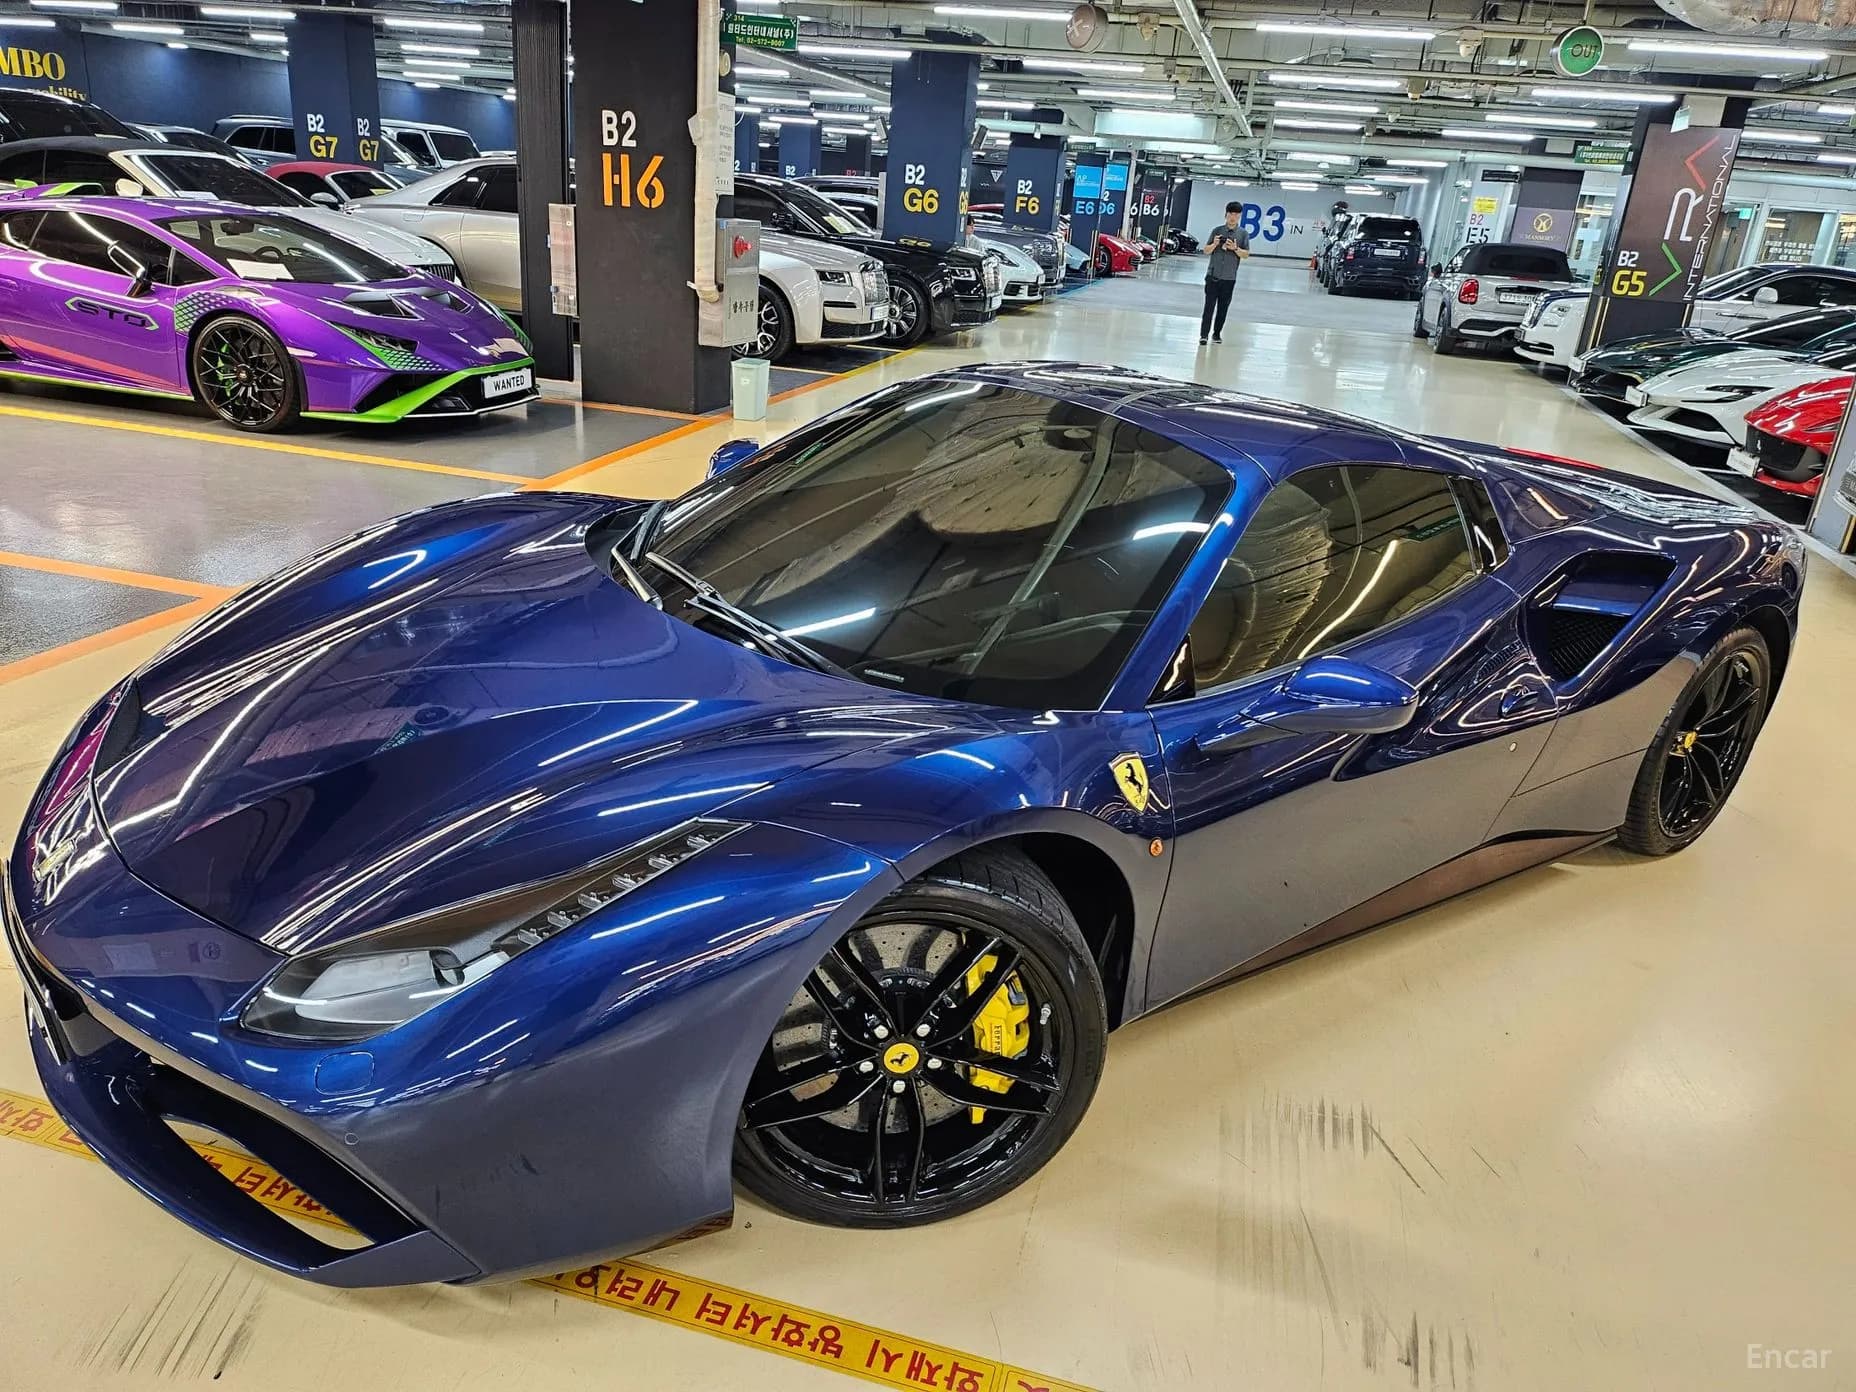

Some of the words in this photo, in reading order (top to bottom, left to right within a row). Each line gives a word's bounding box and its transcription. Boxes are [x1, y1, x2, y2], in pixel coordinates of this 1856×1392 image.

[1571, 43, 1598, 58] OUT
[307, 113, 326, 133] B2
[357, 118, 371, 137] B2
[602, 109, 637, 147] B2
[309, 135, 338, 159] G7
[359, 139, 379, 161] G7
[734, 159, 741, 171] 2
[785, 165, 796, 176] B2
[602, 152, 665, 208] H6
[904, 164, 926, 186] B2
[1017, 180, 1033, 195] B2
[1103, 190, 1110, 202] 2
[903, 188, 939, 214] G6
[1015, 196, 1040, 215] F6
[1075, 200, 1095, 215] E6
[1130, 203, 1138, 215] 6
[1142, 203, 1160, 216] B6
[1240, 203, 1286, 242] B3
[1290, 225, 1304, 235] IN
[1470, 214, 1484, 226] B2
[1682, 134, 1737, 301] INTERNATIONAL
[1466, 227, 1491, 244] E5
[1617, 250, 1640, 268] B2
[1611, 269, 1648, 297] G5
[77, 300, 147, 328] STO
[493, 375, 525, 391] WANTED
[556, 1264, 681, 1312] 내려오
[694, 1292, 844, 1359] 방화셔터
[865, 1339, 984, 1392] 화재시
